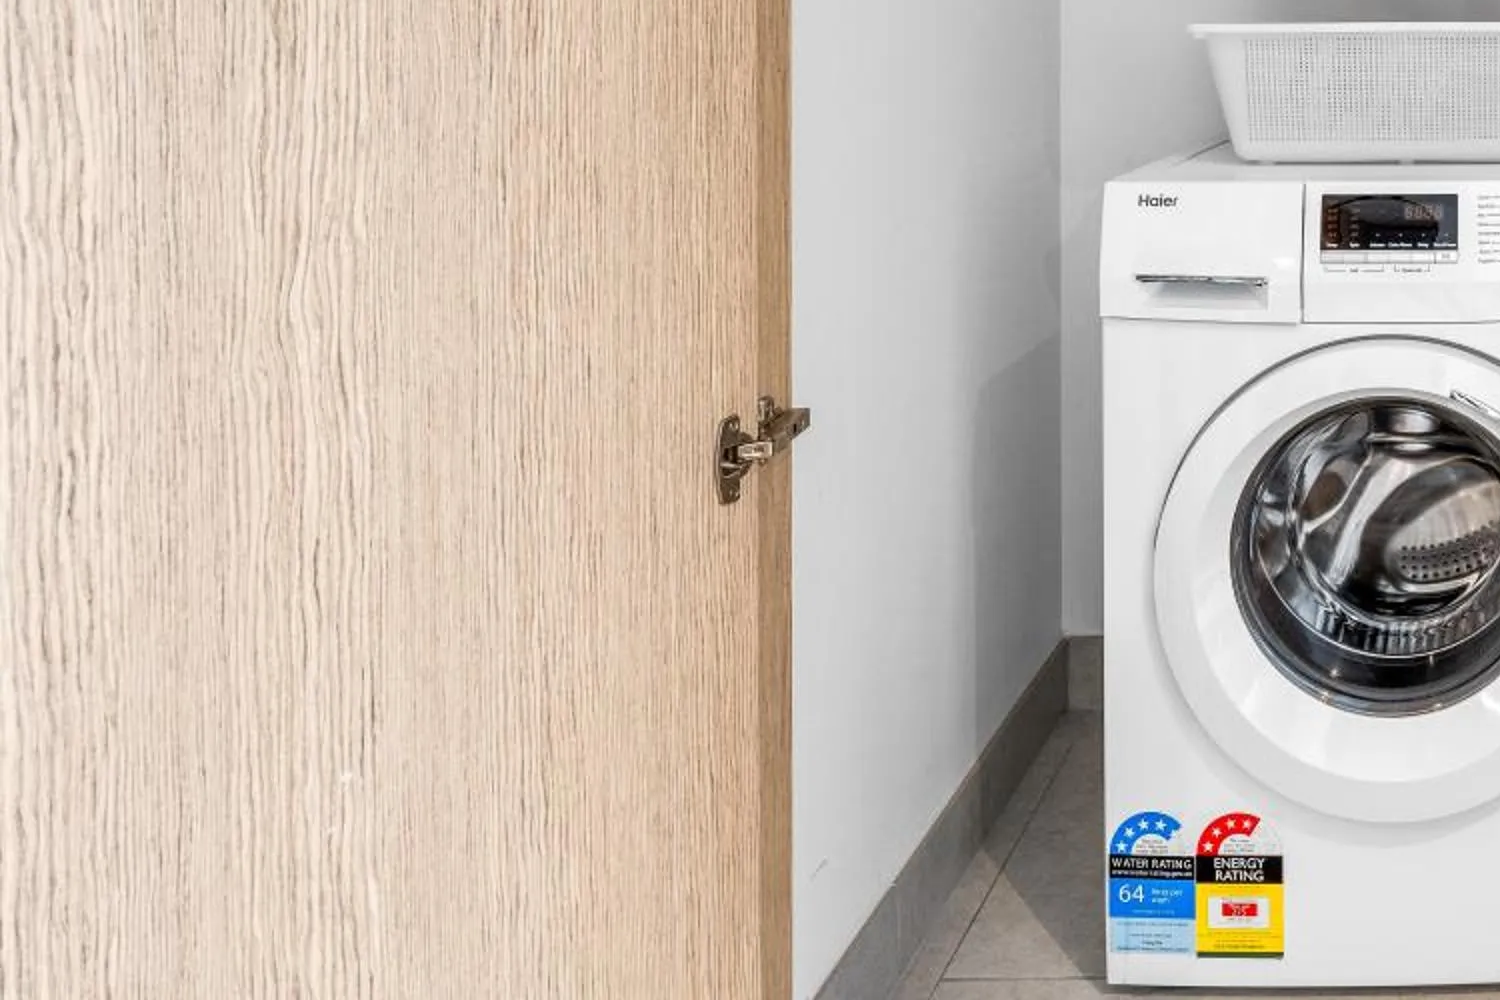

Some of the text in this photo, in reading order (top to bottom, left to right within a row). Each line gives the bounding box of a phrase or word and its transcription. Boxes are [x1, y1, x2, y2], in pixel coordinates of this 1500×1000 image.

[1137, 193, 1179, 207] Haier
[1111, 857, 1193, 870] WATER RATING
[1213, 857, 1265, 869] ENERGY
[1215, 869, 1265, 882] RATING
[1119, 883, 1145, 903] 64
